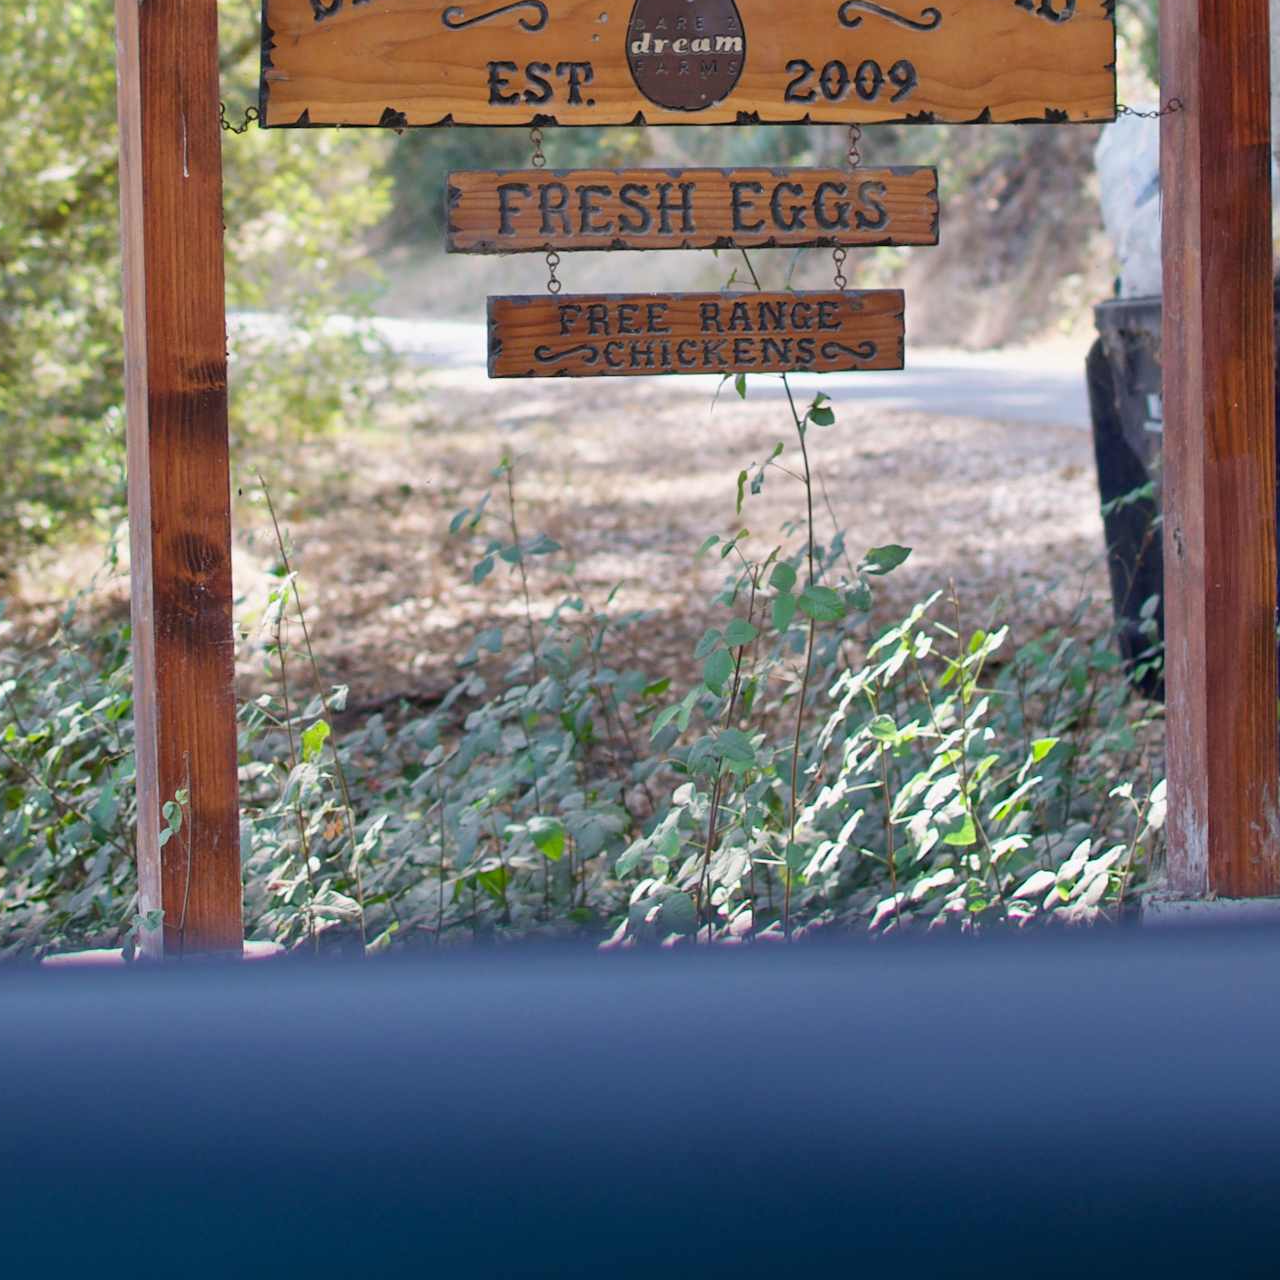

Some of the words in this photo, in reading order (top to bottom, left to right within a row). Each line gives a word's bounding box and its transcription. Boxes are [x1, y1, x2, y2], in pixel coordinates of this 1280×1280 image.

[634, 16, 705, 32] DARE
[631, 32, 744, 55] dream
[486, 60, 596, 107] EST.
[784, 59, 918, 105] 2009
[634, 60, 739, 77] FARMS
[495, 181, 697, 237] FRESH
[729, 180, 893, 234] EGGS
[558, 302, 673, 337] FREE
[698, 300, 844, 335] RANGE
[602, 337, 818, 369] CHICKENS
